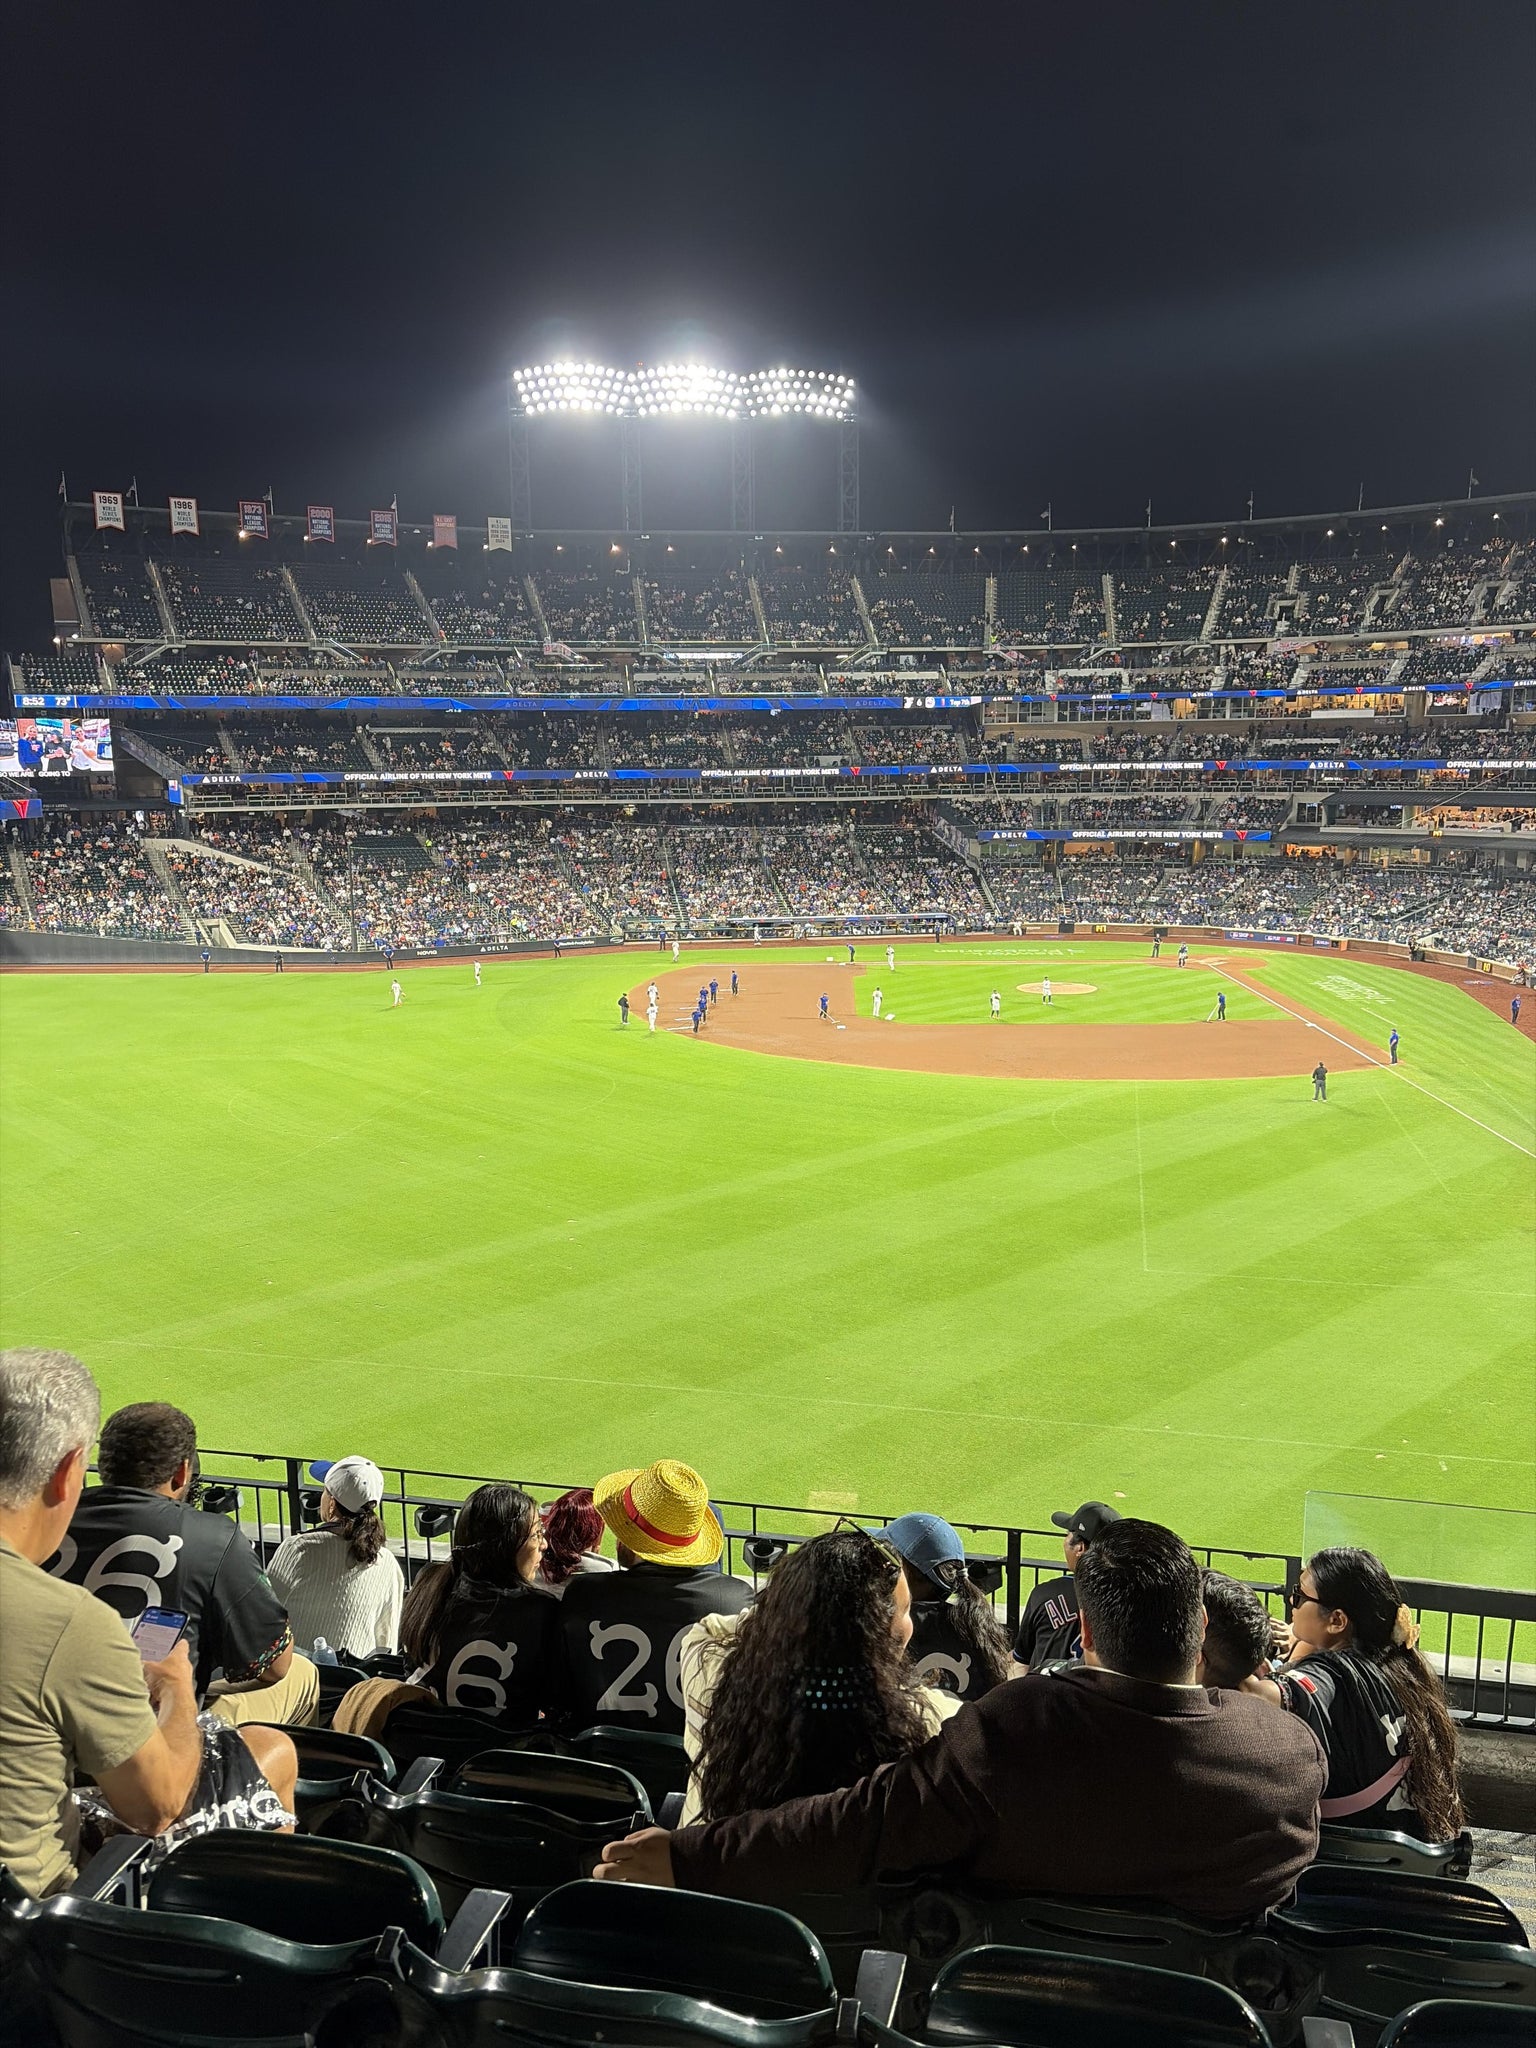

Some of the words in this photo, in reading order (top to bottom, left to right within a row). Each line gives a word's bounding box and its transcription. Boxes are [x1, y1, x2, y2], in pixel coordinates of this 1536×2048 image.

[98, 495, 118, 505] 1969
[173, 501, 193, 510] 1986
[244, 505, 263, 514] 1973
[310, 509, 331, 519] 2000
[22, 697, 45, 706] 8:52
[916, 699, 922, 707] 6
[949, 699, 961, 708] Top
[1059, 763, 1092, 771] OFFICIAL
[1146, 762, 1163, 770] NEW
[1163, 762, 1183, 770] YORK
[1446, 761, 1481, 769] OFFICIAL
[1482, 760, 1512, 768] AIRLINE
[1513, 760, 1524, 768] OF
[1525, 760, 1536, 768] TH
[344, 773, 379, 781] OFFICIAL
[380, 772, 409, 780] AIRLINE
[409, 772, 420, 780] OF
[420, 772, 435, 780] THE
[435, 771, 452, 780] NEW
[452, 771, 472, 780] YORK
[472, 771, 492, 779] METS
[701, 768, 733, 777] OFFICIAL
[733, 768, 761, 776] AIRLINE
[761, 768, 771, 776] OF
[771, 768, 785, 776] THE
[785, 768, 801, 776] NEW
[801, 768, 821, 776] YORK
[821, 767, 840, 775] METS
[211, 775, 241, 783] DELTA
[38, 1533, 184, 1633] 6
[1044, 1594, 1079, 1631] AL
[440, 1640, 518, 1718] 6
